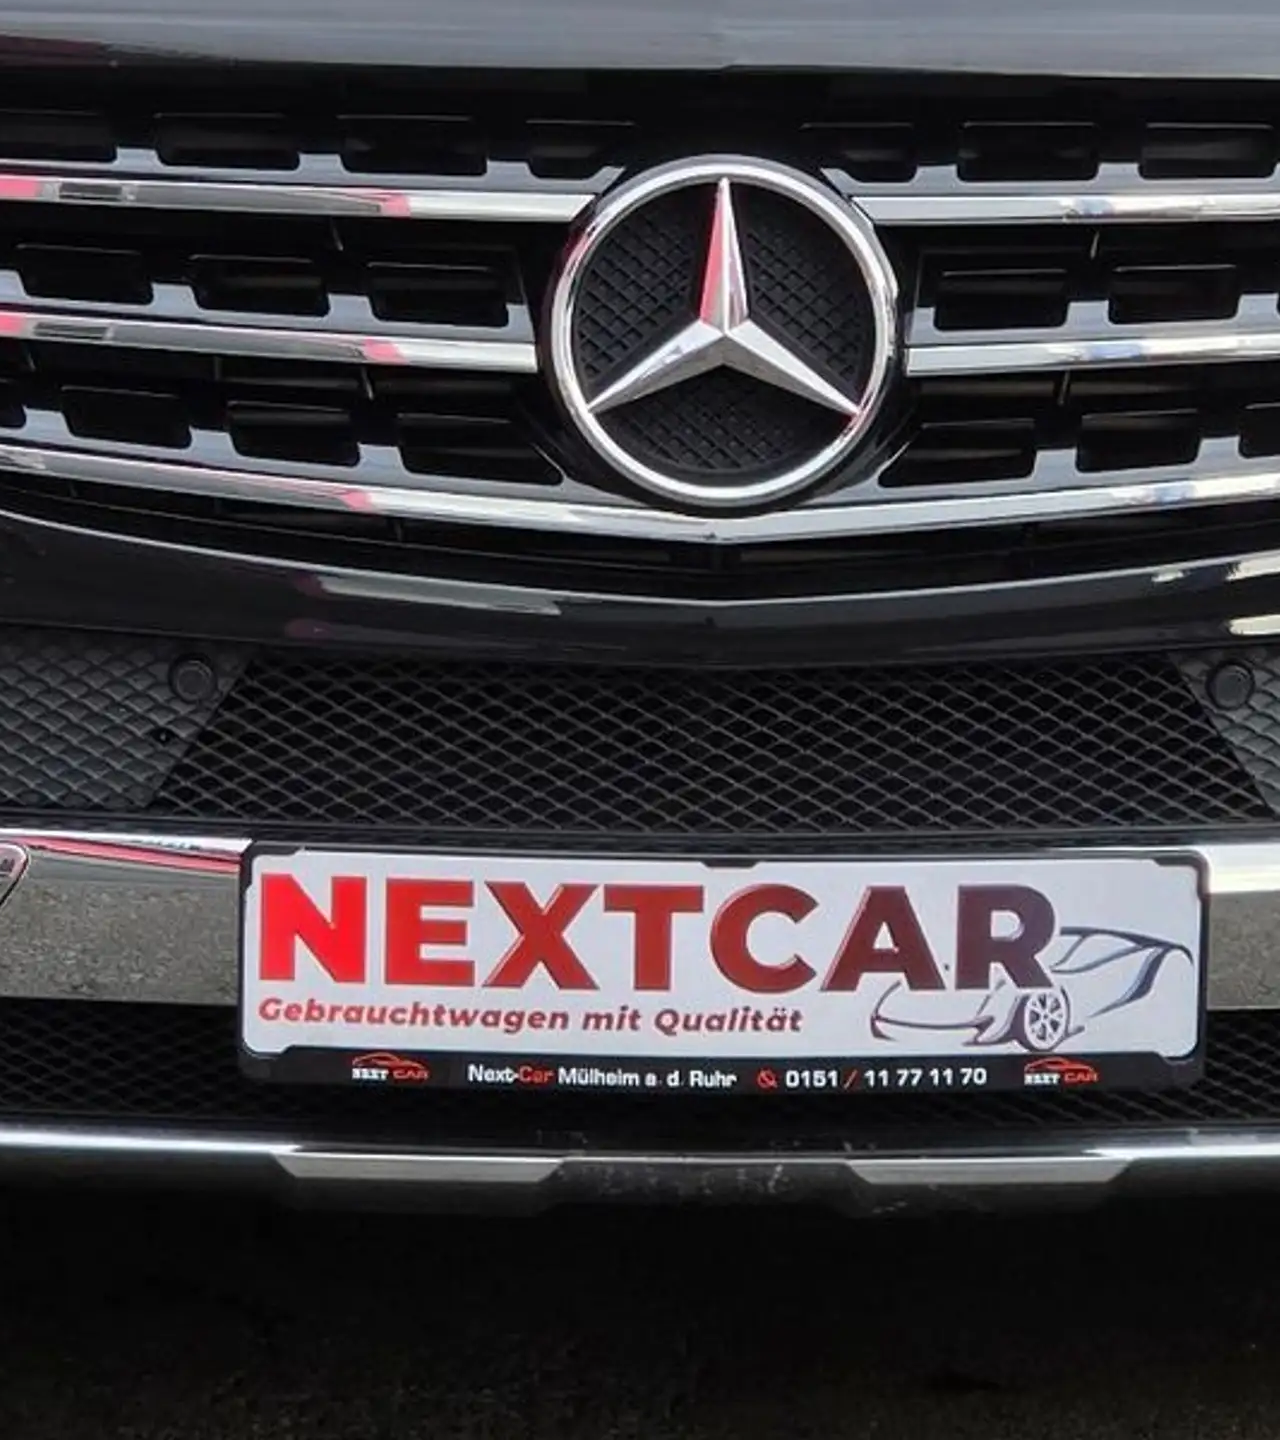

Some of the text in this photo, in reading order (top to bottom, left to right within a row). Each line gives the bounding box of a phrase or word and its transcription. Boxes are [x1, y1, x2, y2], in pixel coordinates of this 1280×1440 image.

[258, 872, 1058, 993] NEXTCAR
[258, 997, 803, 1037] Gebrauchtwagen mit Qualität
[558, 1066, 640, 1088] Mülheim
[689, 1069, 738, 1088] Ruhr
[785, 1068, 838, 1088] 0151
[864, 1069, 890, 1087] 11
[896, 1069, 921, 1087] 77
[929, 1068, 954, 1086] 11
[960, 1066, 988, 1086] 70
